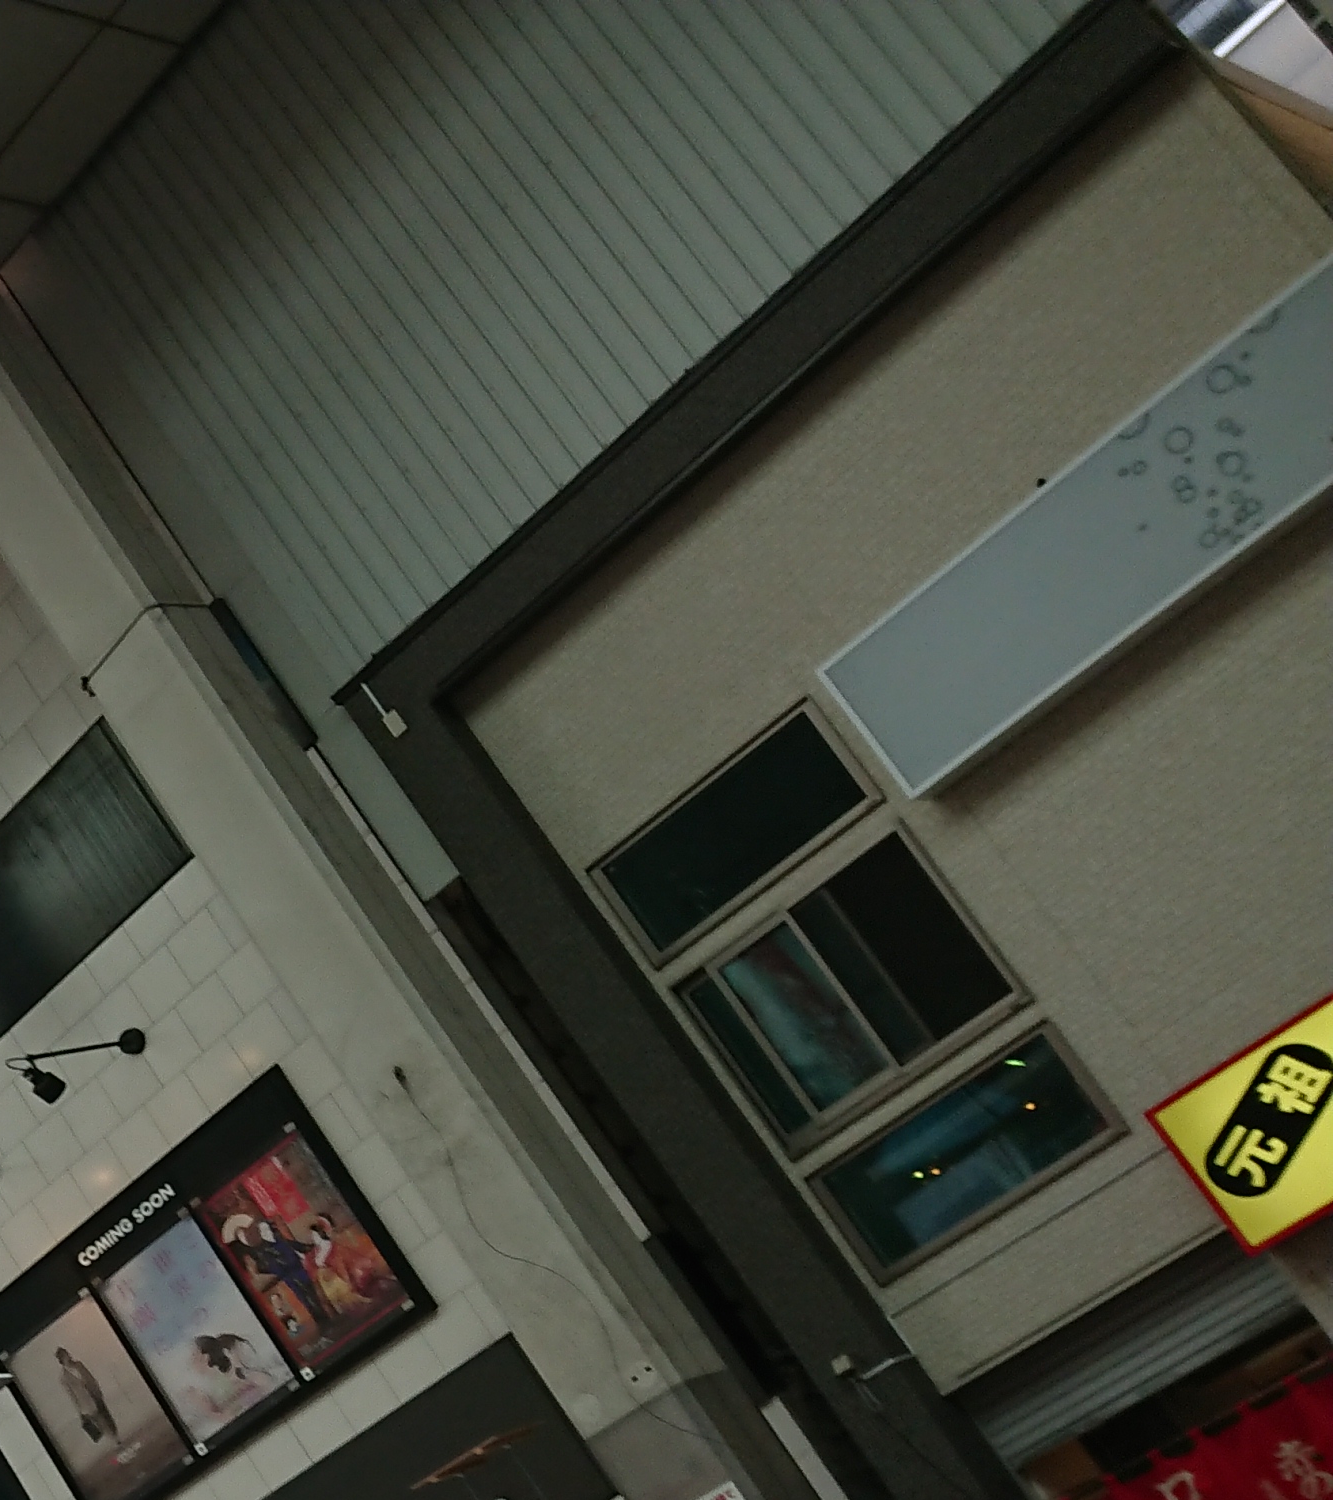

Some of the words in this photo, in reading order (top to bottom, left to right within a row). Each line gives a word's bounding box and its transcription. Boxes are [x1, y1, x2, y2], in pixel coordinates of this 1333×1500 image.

[1217, 1052, 1331, 1188] 元祖
[77, 1217, 134, 1268] COMING
[131, 1183, 177, 1225] SOON
